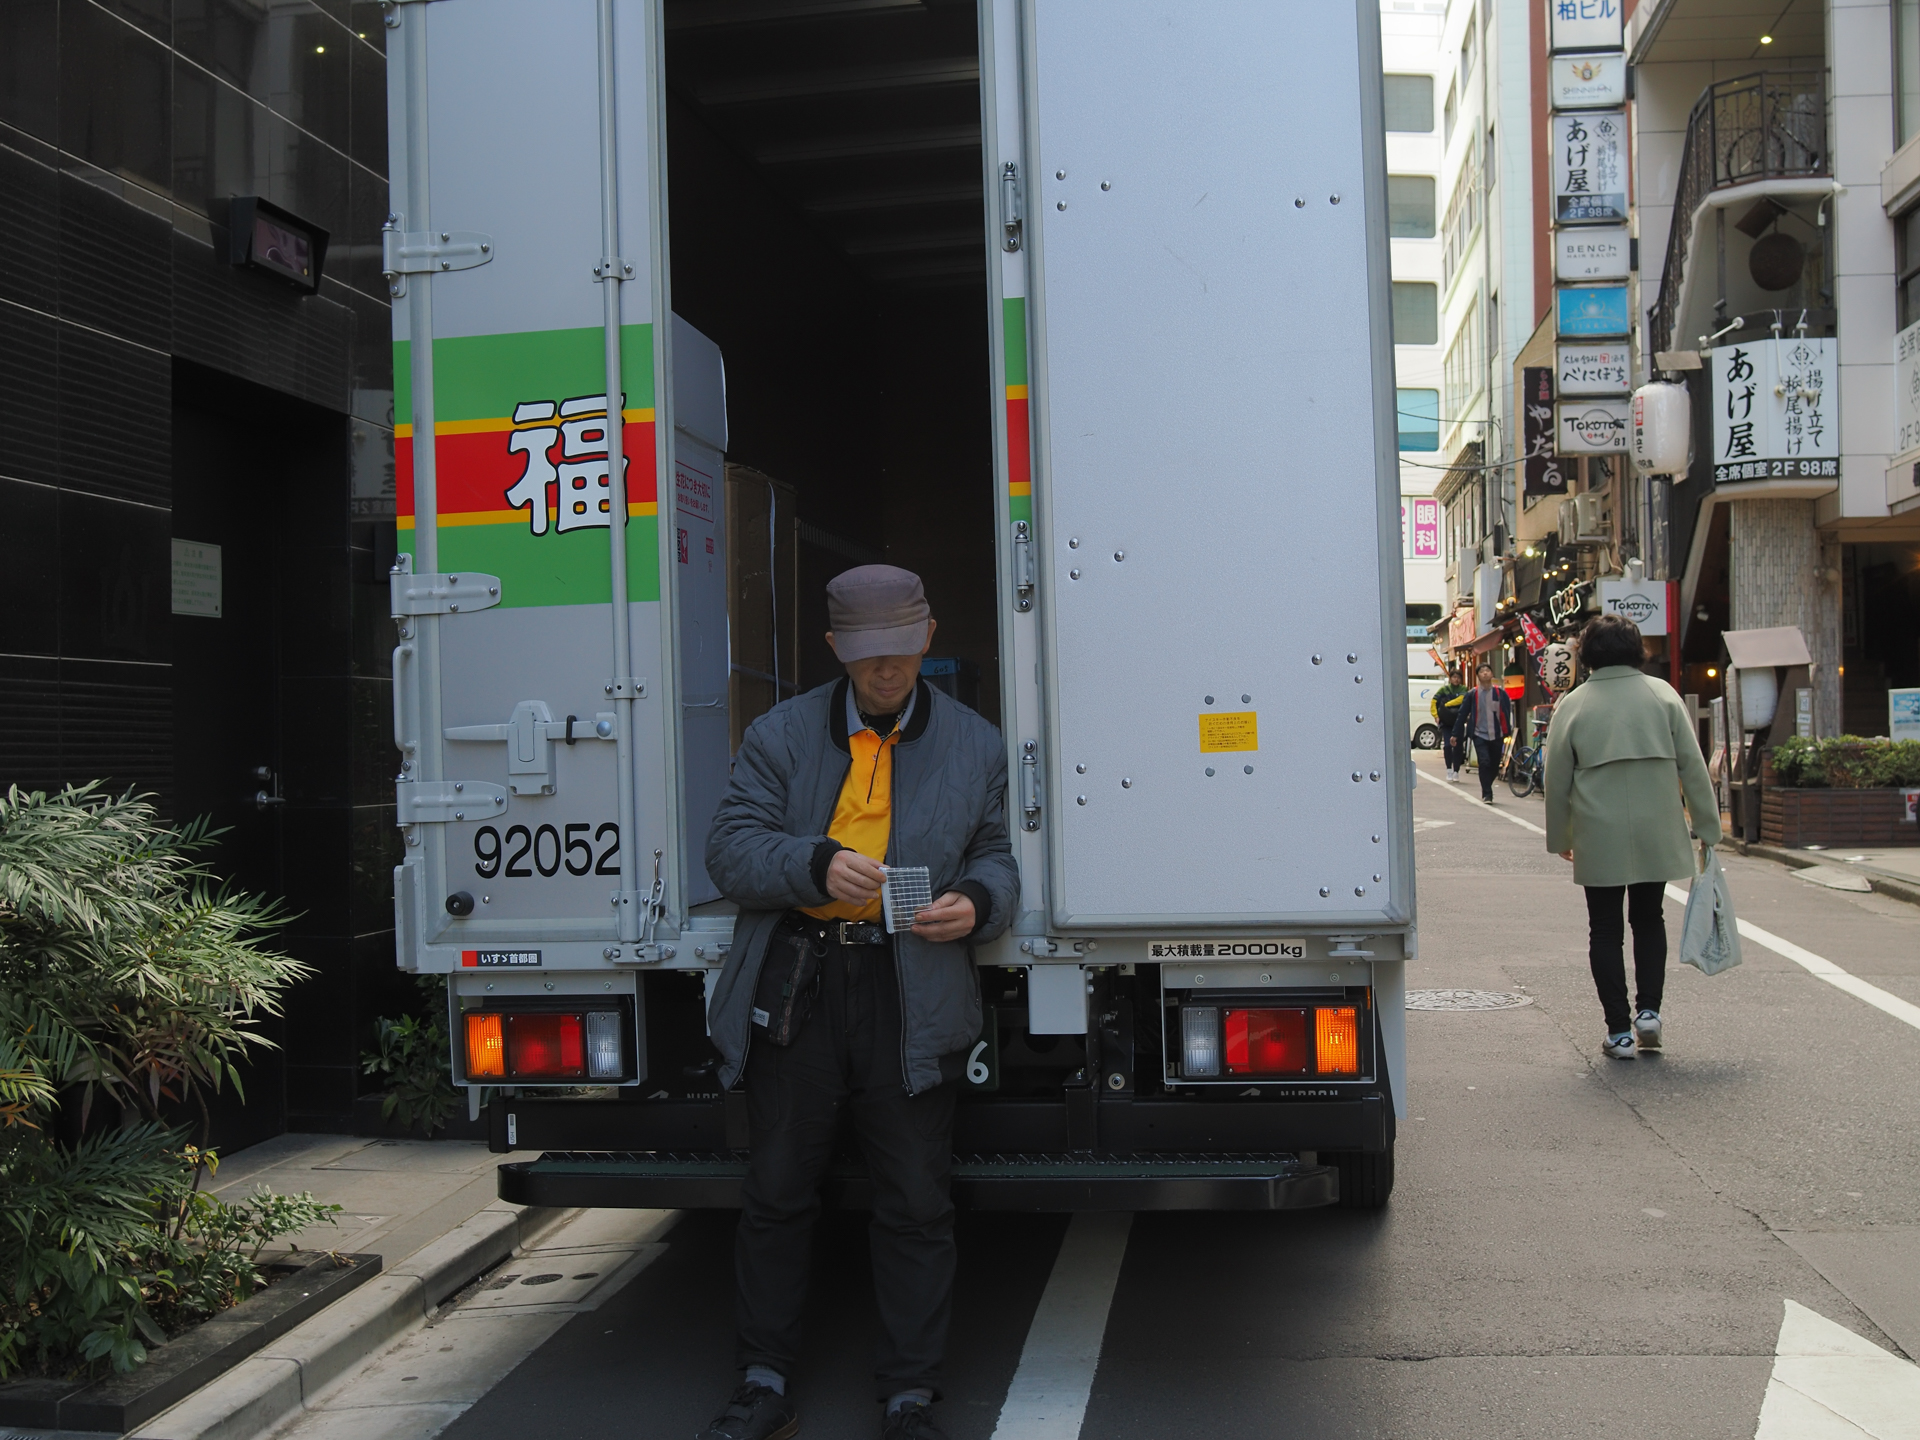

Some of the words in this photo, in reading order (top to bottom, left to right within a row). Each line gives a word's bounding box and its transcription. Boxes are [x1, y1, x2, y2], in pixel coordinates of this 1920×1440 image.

[1557, 0, 1616, 20] 柏ビル
[1564, 118, 1590, 192] あげ屋
[1568, 196, 1613, 207] 全席個室
[1569, 207, 1585, 218] 2F
[1588, 206, 1613, 217] 98席
[1725, 347, 1757, 458] あげ屋
[1614, 437, 1626, 446] B1
[503, 393, 631, 537] 福
[1715, 461, 1768, 482] 全席個室
[1771, 461, 1795, 476] 2F
[1799, 460, 1837, 477] 98席
[1416, 504, 1436, 551] 眼科
[1608, 599, 1660, 611] TOKOTON
[1553, 648, 1571, 688] らあ麺
[474, 822, 620, 879] 92052
[480, 952, 538, 964] いすゞ首都圏
[1151, 943, 1215, 958] 最大積載量
[1217, 943, 1303, 958] 2000kg
[966, 1041, 989, 1084] 6
